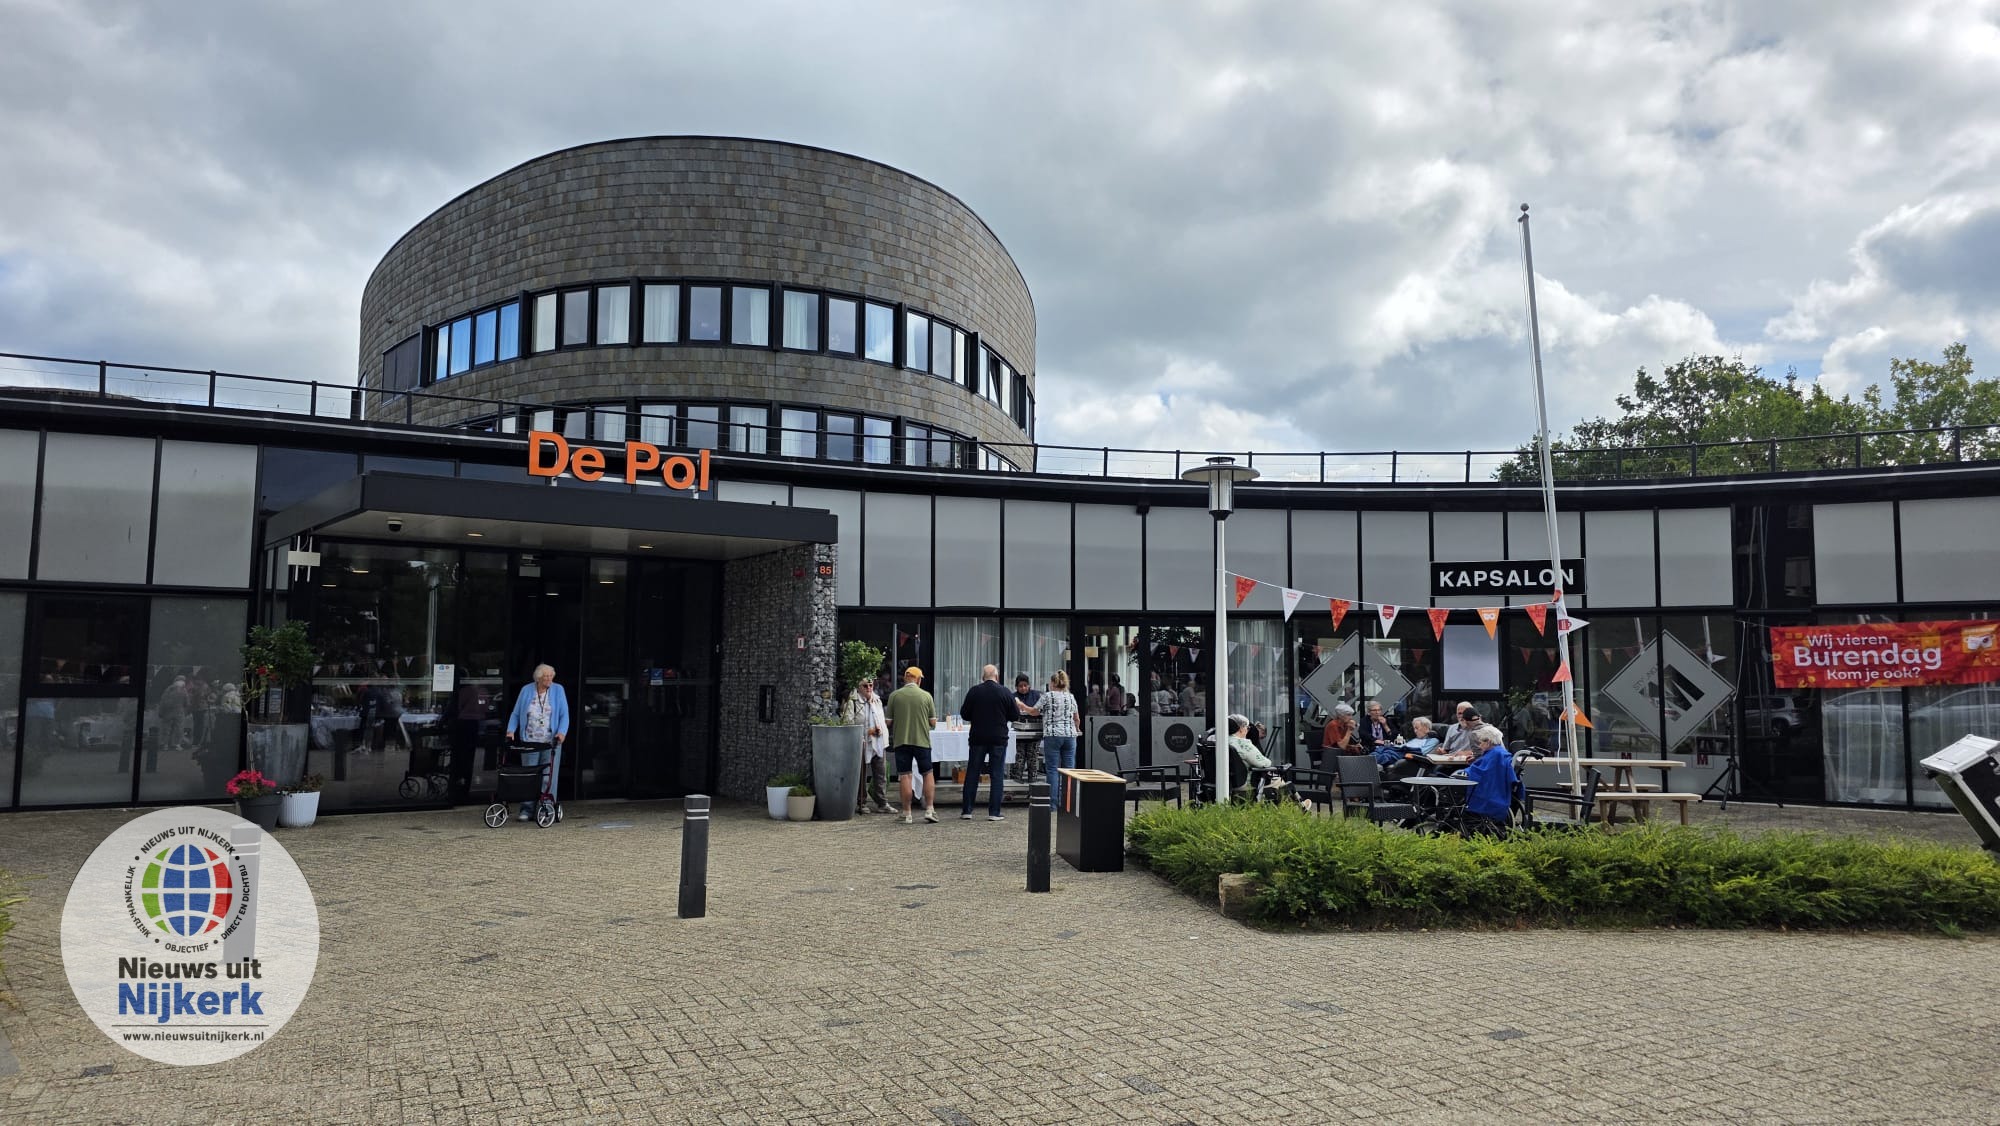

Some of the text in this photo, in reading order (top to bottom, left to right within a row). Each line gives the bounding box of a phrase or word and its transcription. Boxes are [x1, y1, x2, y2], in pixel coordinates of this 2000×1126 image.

[528, 431, 711, 491] De Pol
[819, 565, 832, 575] 85
[1439, 568, 1574, 587] KAPSALON
[1807, 634, 1888, 649] Wij vieren
[1793, 643, 1942, 670] Burendag
[1865, 669, 1879, 683] je
[1883, 667, 1921, 679] ook?
